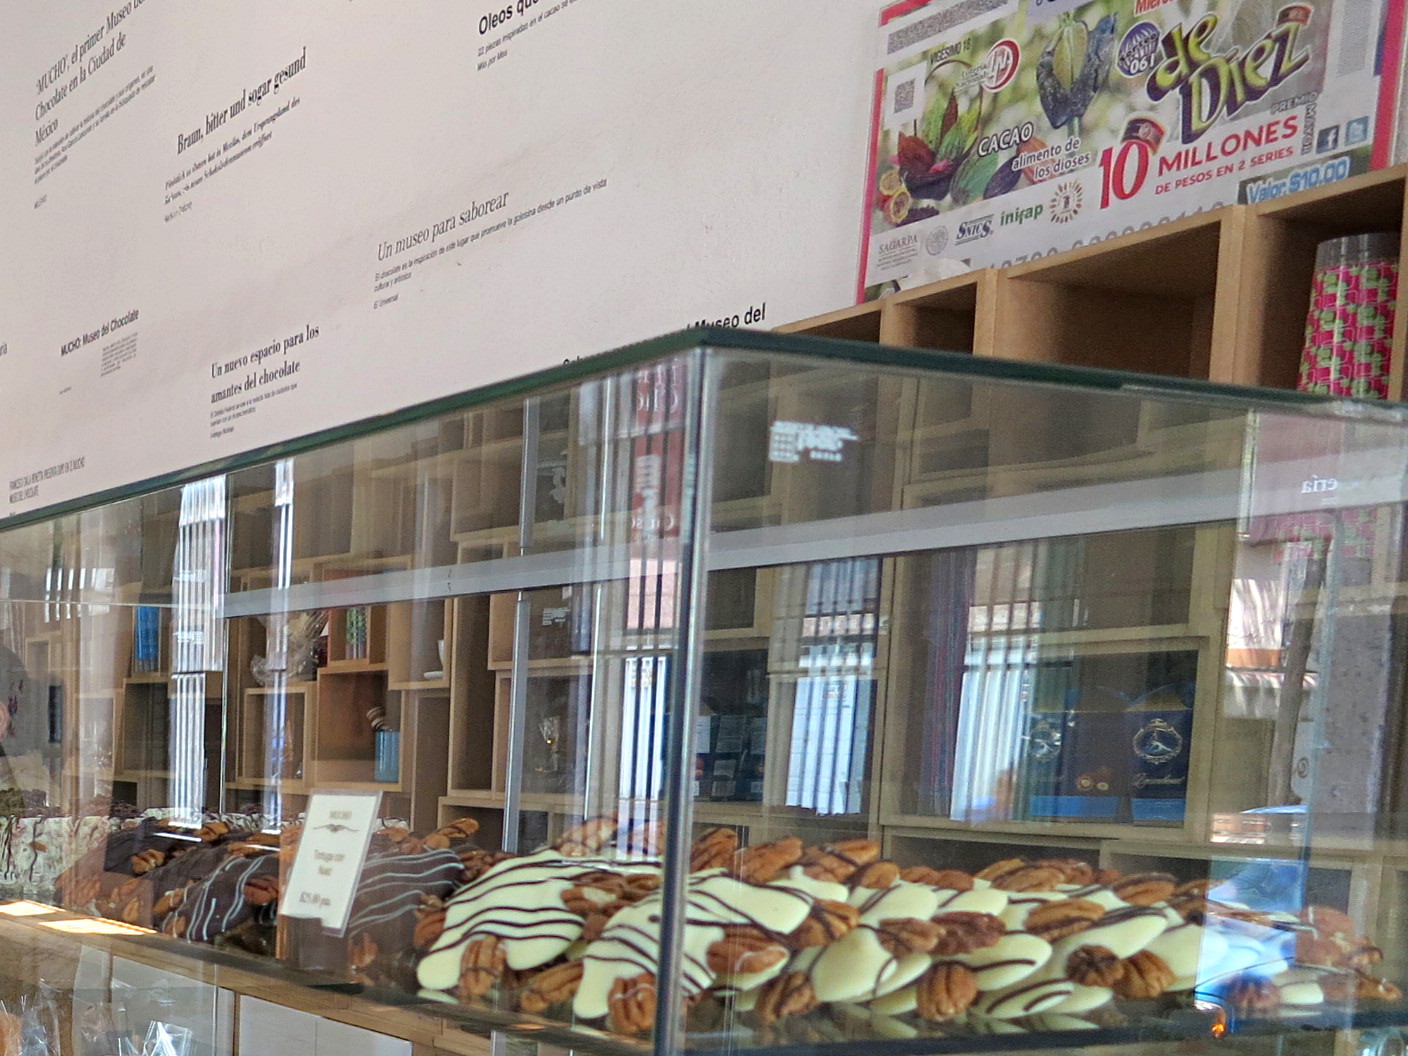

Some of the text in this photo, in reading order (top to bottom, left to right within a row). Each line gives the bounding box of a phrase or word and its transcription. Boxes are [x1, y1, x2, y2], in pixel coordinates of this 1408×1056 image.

[106, 2, 132, 34] Museo
[478, 5, 513, 35] Oleos
[1130, 54, 1154, 74] 061
[1146, 13, 1218, 102] de
[35, 31, 127, 121] Chocolate en la Ciudad de
[1179, 22, 1312, 145] Diez
[177, 46, 306, 156] Braun, bitter und sogar gesund
[1271, 91, 1318, 115] PREMIO
[978, 121, 1034, 157] CACAO
[1011, 136, 1080, 172] alimento de
[1034, 151, 1090, 180] los dioses
[1099, 114, 1299, 210] 10 MILLONES
[1155, 146, 1294, 195] DE PESOS EN 2 SERIES
[1289, 157, 1350, 193] $10.00
[377, 192, 509, 261] Un museo para saborear
[1000, 203, 1044, 227] inifap
[878, 234, 918, 255] SAGARPA
[82, 330, 100, 346] Museo
[101, 322, 110, 338] del
[110, 309, 139, 332] Chocolate
[744, 302, 766, 325] del
[211, 324, 320, 379] Un nuevo espacio para los
[210, 360, 301, 404] amantes del chocolate
